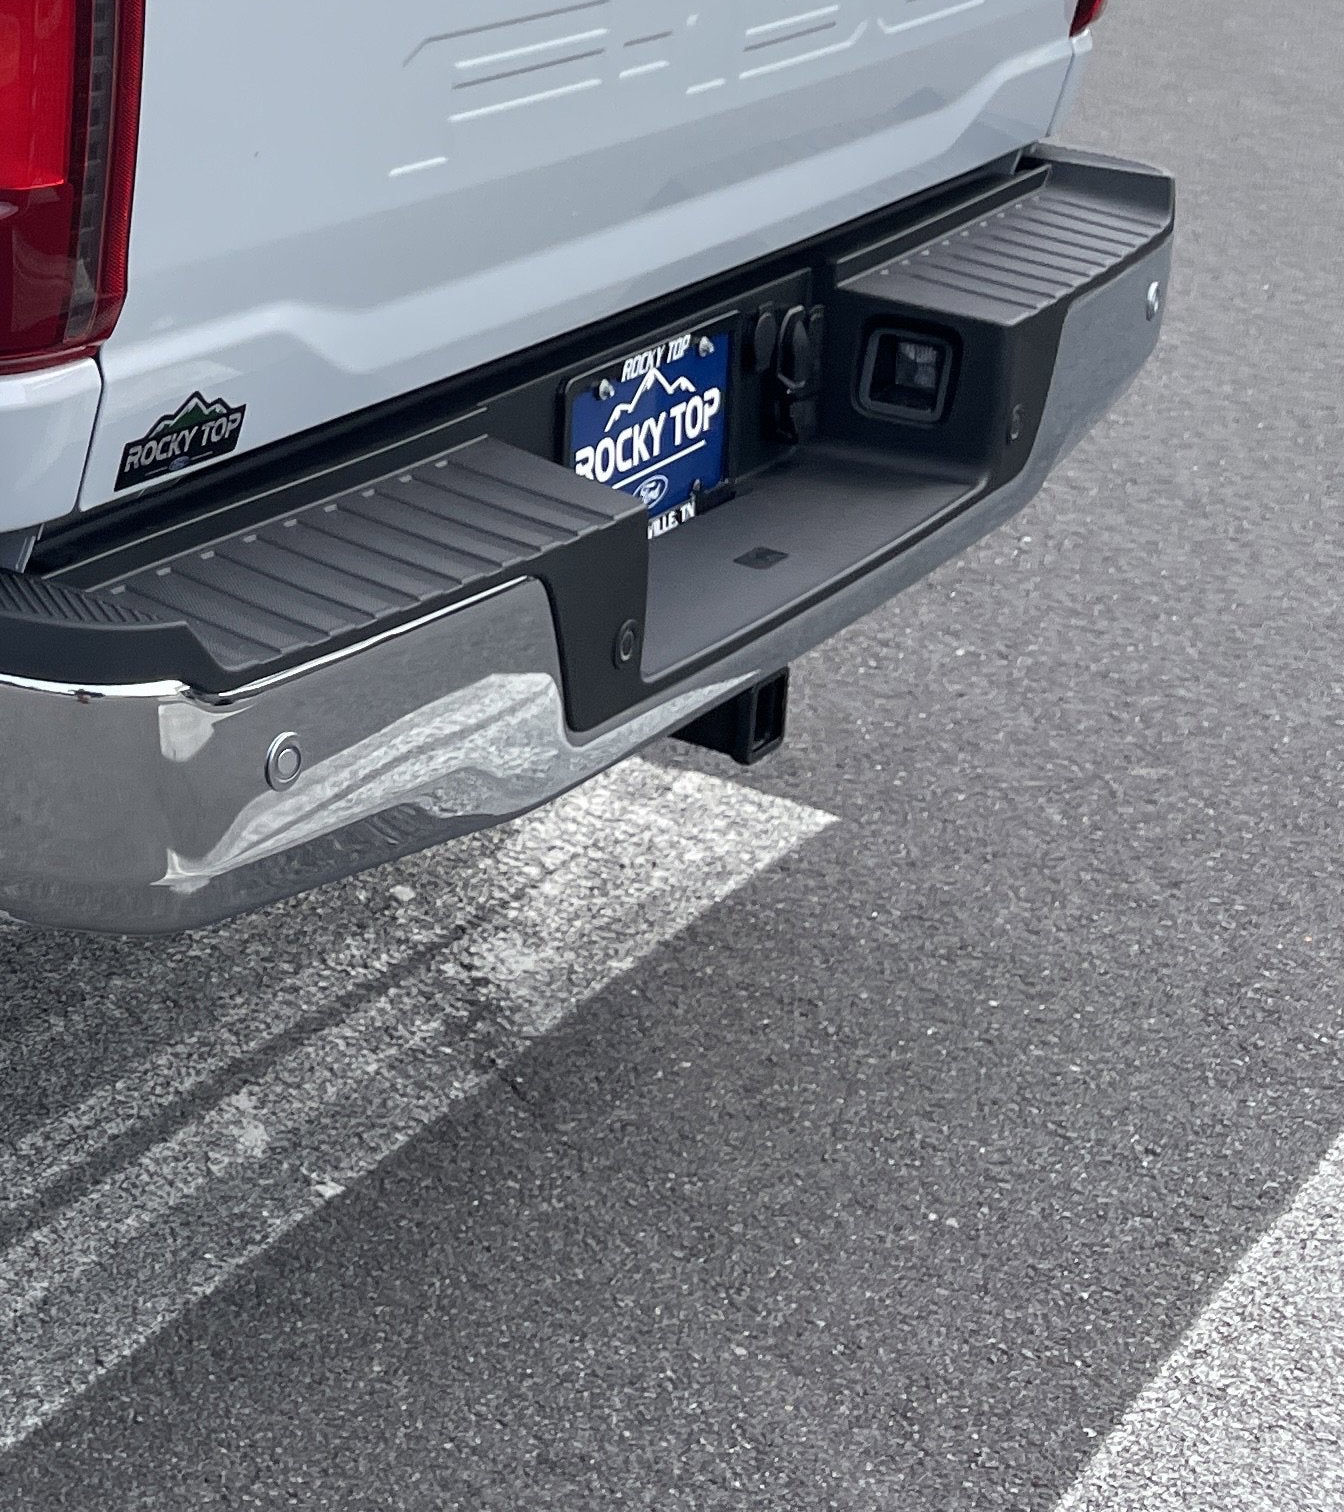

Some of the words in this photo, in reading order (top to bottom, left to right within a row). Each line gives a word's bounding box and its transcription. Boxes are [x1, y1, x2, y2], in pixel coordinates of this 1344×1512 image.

[621, 344, 666, 383] ROCKY
[666, 334, 692, 364] TOP
[123, 425, 199, 473] ROCKY
[201, 411, 242, 447] TOP
[574, 410, 667, 484] ROCKY
[669, 386, 721, 447] TOP
